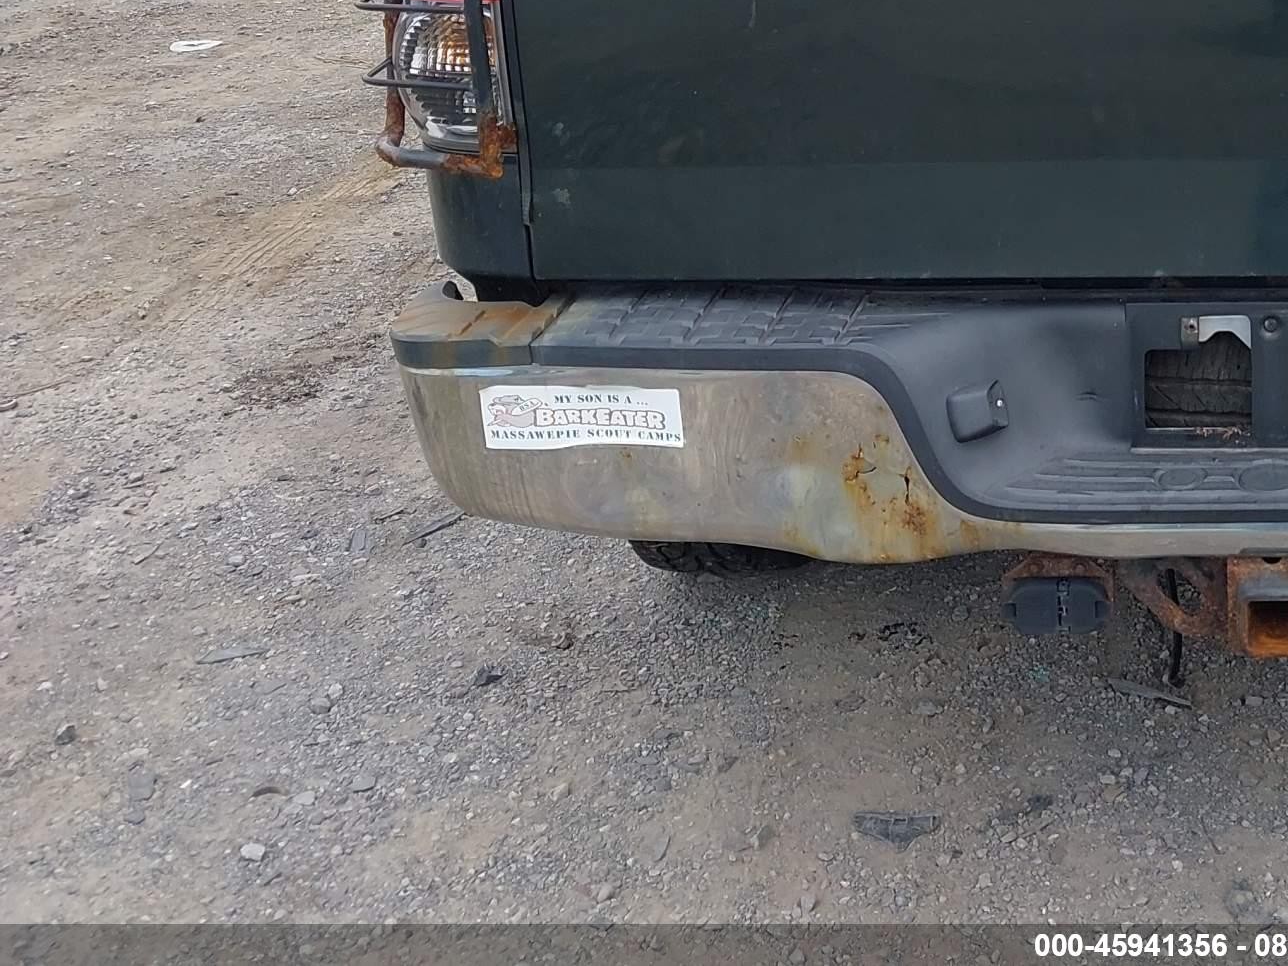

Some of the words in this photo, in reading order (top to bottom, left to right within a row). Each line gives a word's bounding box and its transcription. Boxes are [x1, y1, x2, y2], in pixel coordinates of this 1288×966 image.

[553, 394, 572, 404] MY
[577, 394, 602, 404] SON
[607, 394, 620, 404] IS
[624, 395, 633, 405] A
[534, 408, 666, 430] BARKEATER
[490, 429, 581, 440] MASSAWEPIE
[586, 428, 632, 439] SCOUT
[637, 430, 682, 443] CAMPS
